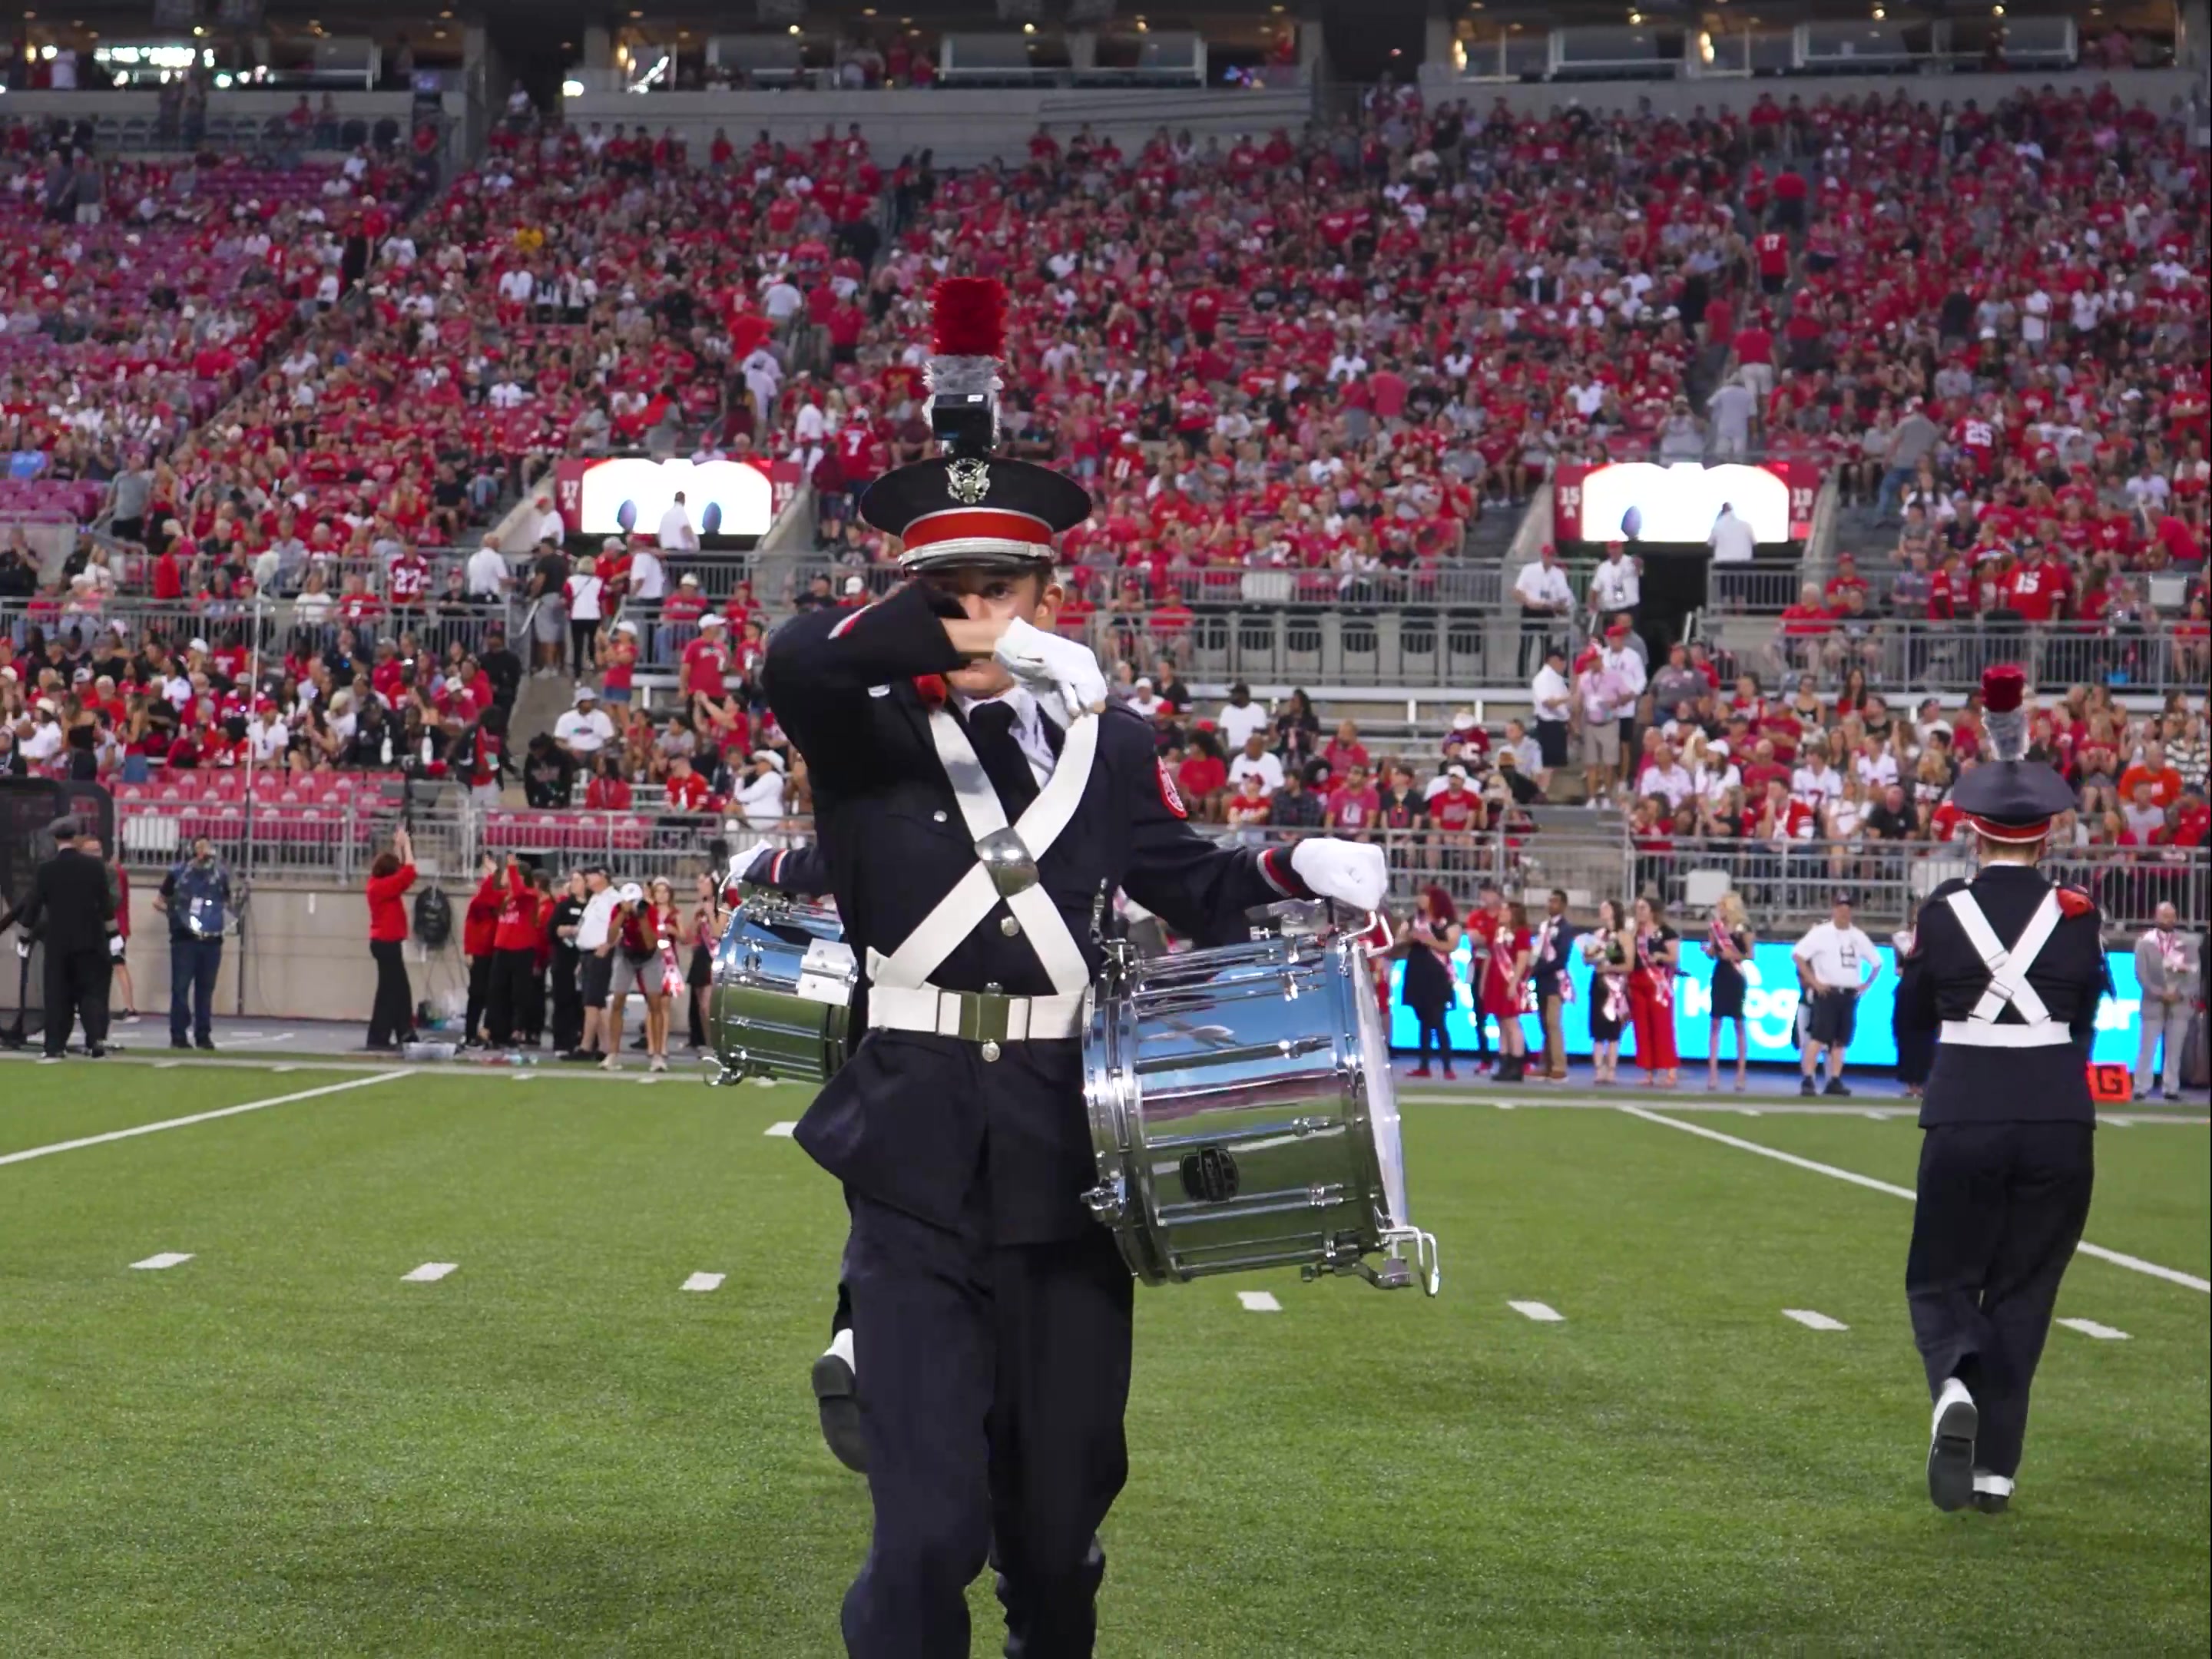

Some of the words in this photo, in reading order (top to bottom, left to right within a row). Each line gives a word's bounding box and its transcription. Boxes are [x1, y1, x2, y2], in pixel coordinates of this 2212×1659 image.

[1965, 419, 1992, 447] 25
[2015, 571, 2041, 594] 15
[1808, 788, 1825, 810] 7
[2095, 1064, 2124, 1095] G
